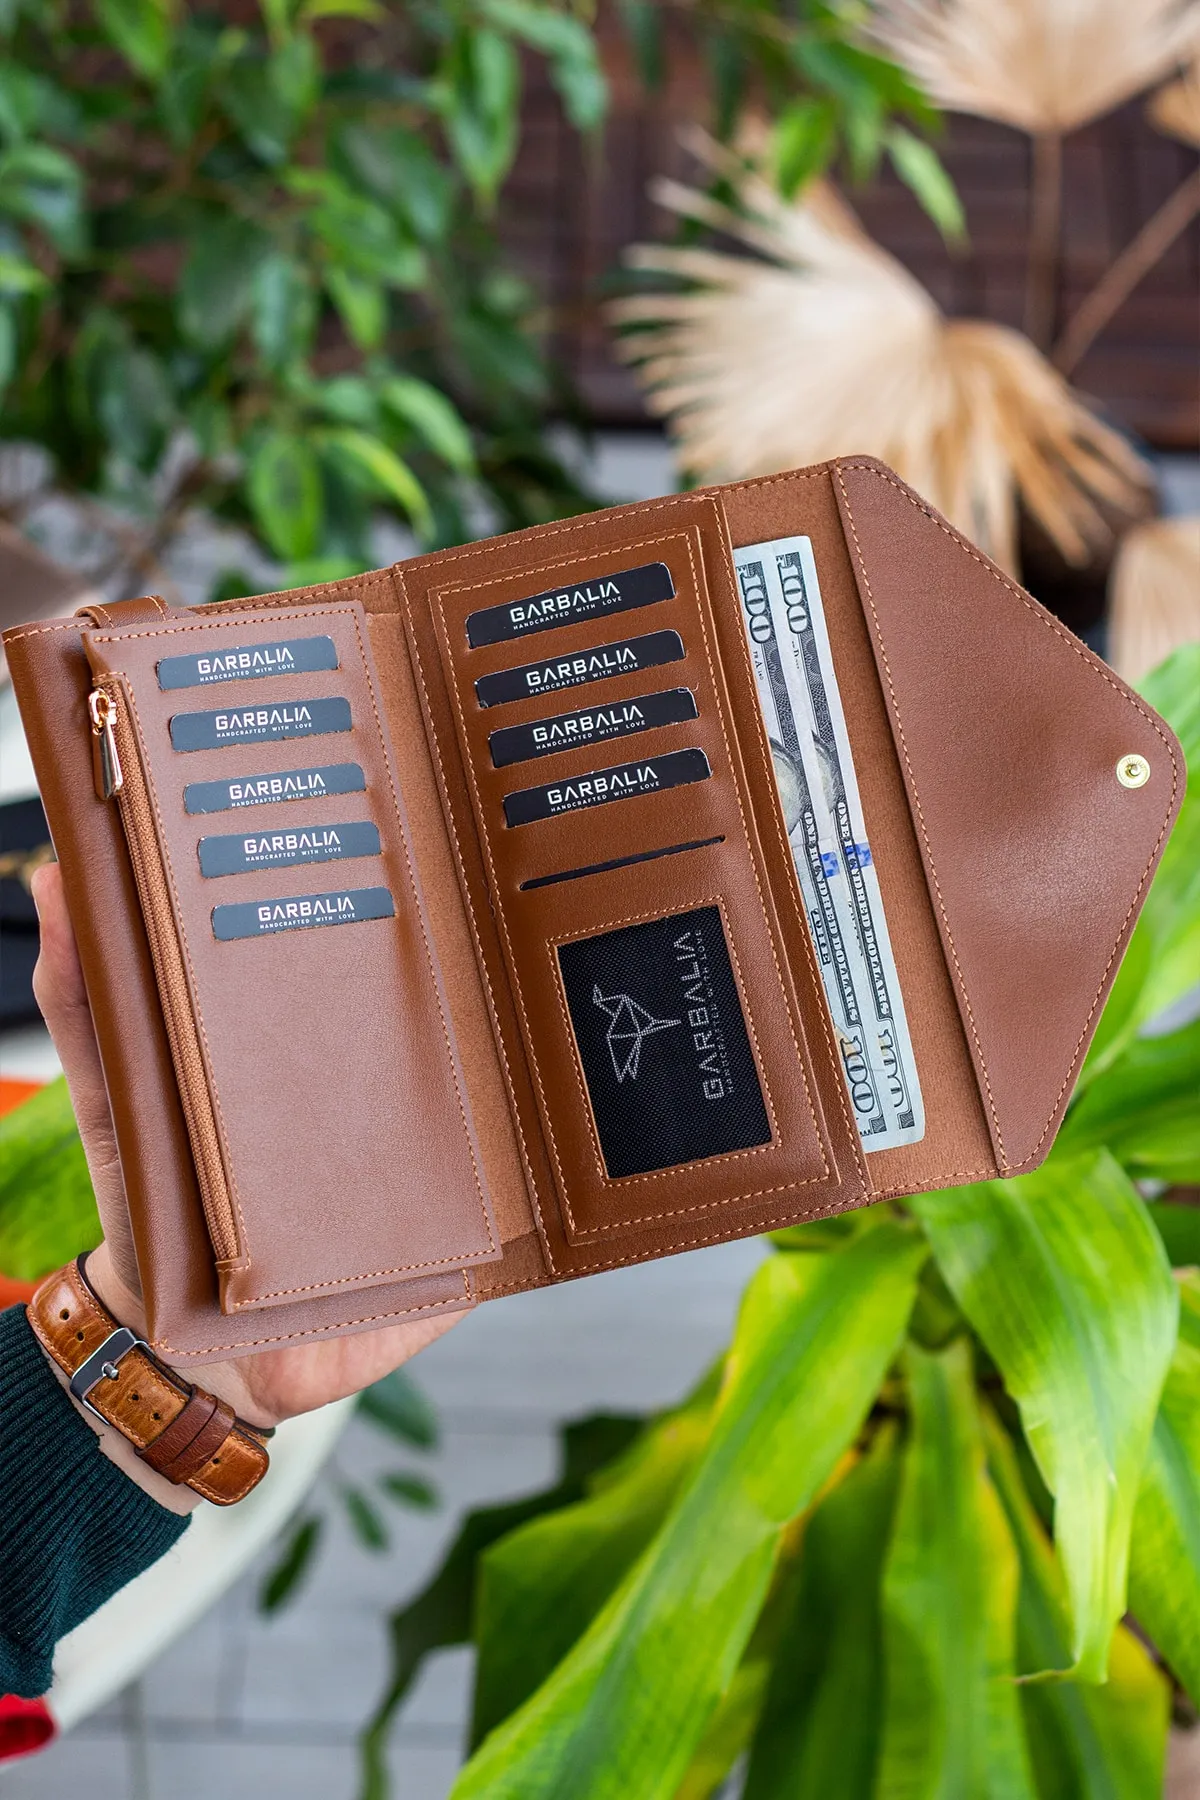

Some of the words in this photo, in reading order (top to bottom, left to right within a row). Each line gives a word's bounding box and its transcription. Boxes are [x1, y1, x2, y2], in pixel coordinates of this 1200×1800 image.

[510, 582, 620, 623] GARBALIA
[513, 610, 570, 630] HANDCRAFTED
[576, 604, 596, 613] WITH
[602, 596, 622, 606] LOVE
[740, 572, 772, 644] 100
[778, 564, 808, 634] 100
[197, 647, 294, 674] GARBALIA
[199, 670, 250, 682] HANDCRAFTED
[526, 648, 637, 687] GARBALIA
[529, 676, 586, 694] HANDCRAFTED
[592, 669, 612, 679] WITH
[618, 662, 639, 672] LOVE
[215, 706, 312, 731] GARBALIA
[216, 728, 267, 738] HANDCRAFTED
[533, 704, 644, 743] GARBALIA
[536, 732, 593, 750] HANDCRAFTED
[599, 726, 619, 735] WITH
[626, 720, 646, 729] LOVE
[228, 773, 325, 801] GARBALIA
[547, 766, 658, 805] GARBALIA
[551, 794, 607, 812] HANDCRAFTED
[614, 787, 634, 796] WITH
[640, 781, 660, 790] LOVE
[231, 795, 281, 808] HANDCRAFTED
[244, 831, 341, 854] GARBALIA
[245, 851, 296, 862] HANDCRAFTED
[257, 897, 355, 921] GARBALIA
[259, 918, 310, 929] HANDCRAFTED
[833, 937, 859, 1021] DOLLARS
[866, 931, 890, 1015] DOLLARS
[674, 932, 724, 1100] GARBALIA
[840, 1036, 874, 1113] 100
